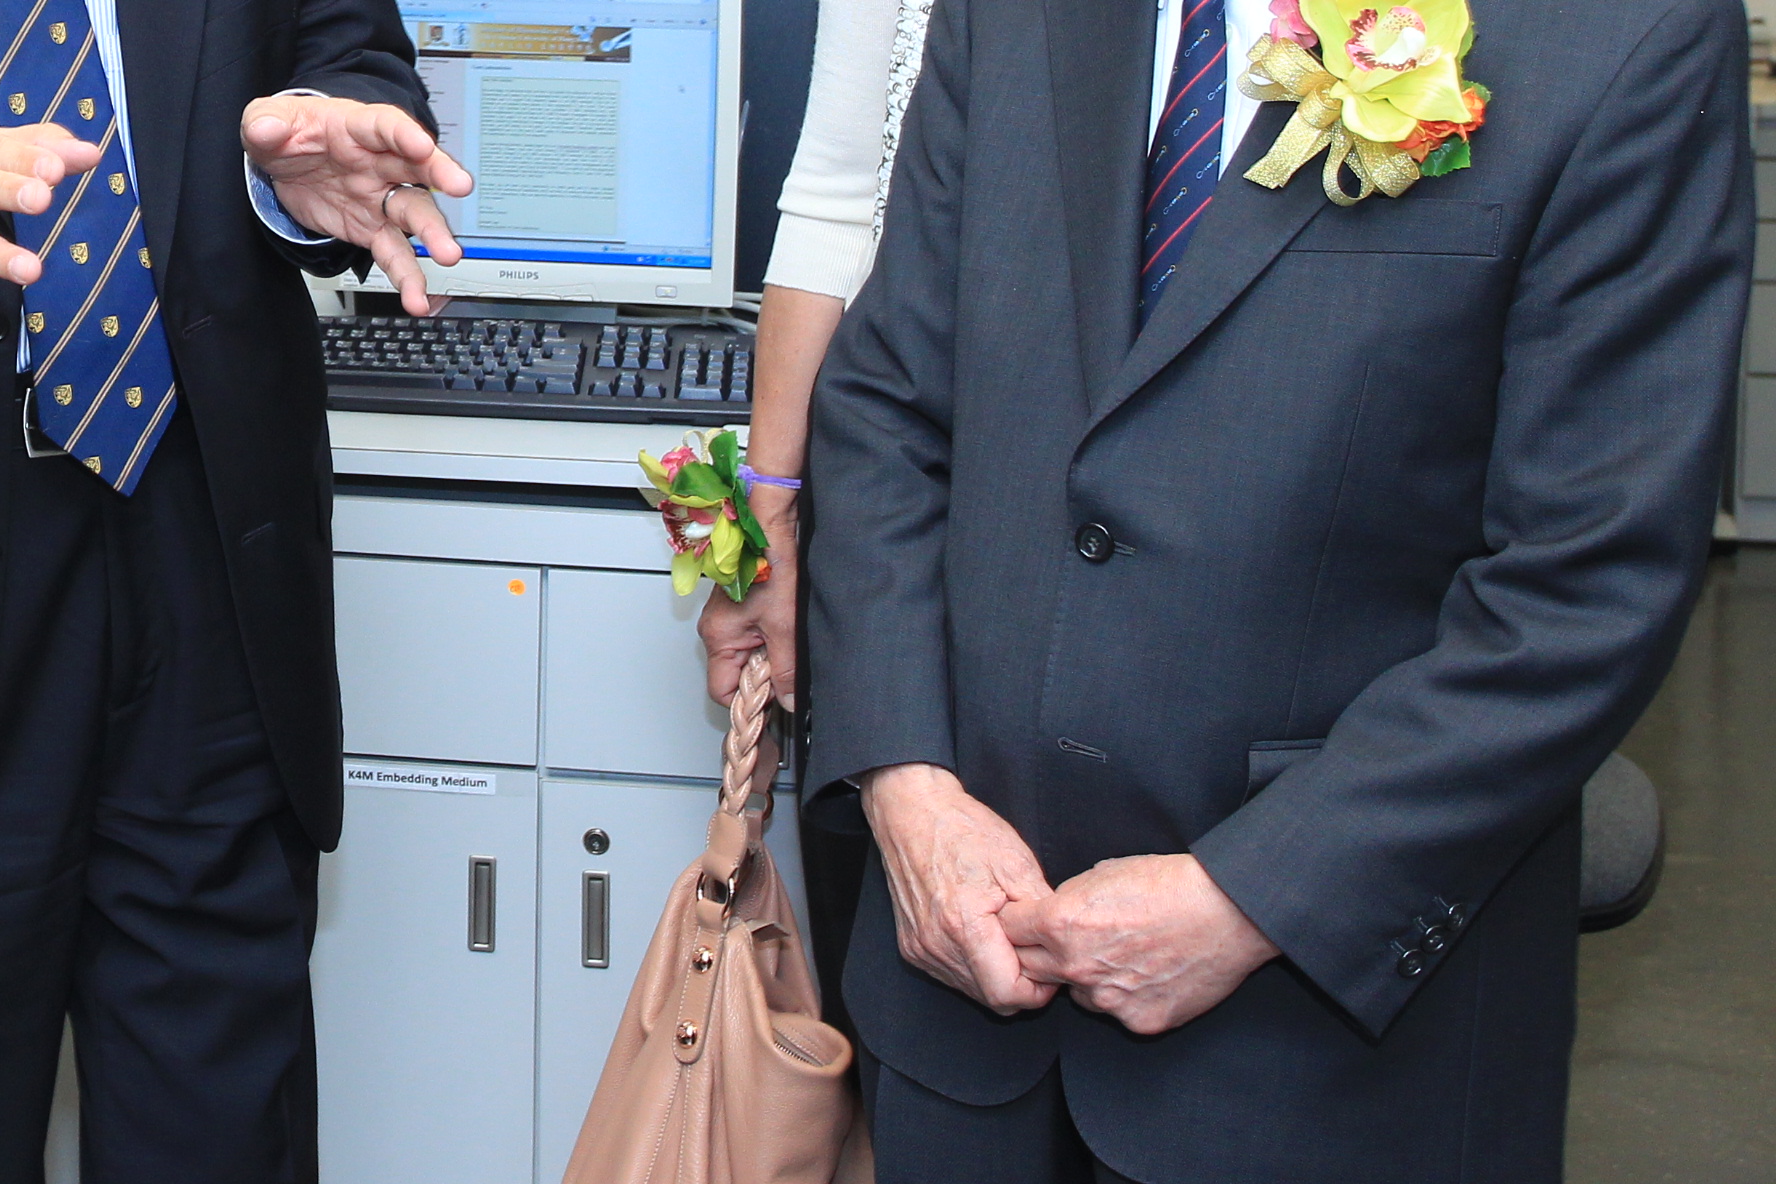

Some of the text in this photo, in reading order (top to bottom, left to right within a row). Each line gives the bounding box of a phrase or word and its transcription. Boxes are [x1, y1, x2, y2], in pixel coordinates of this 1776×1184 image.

[499, 270, 540, 280] PHILIPS
[348, 769, 488, 789] K4M Embedding Medium
